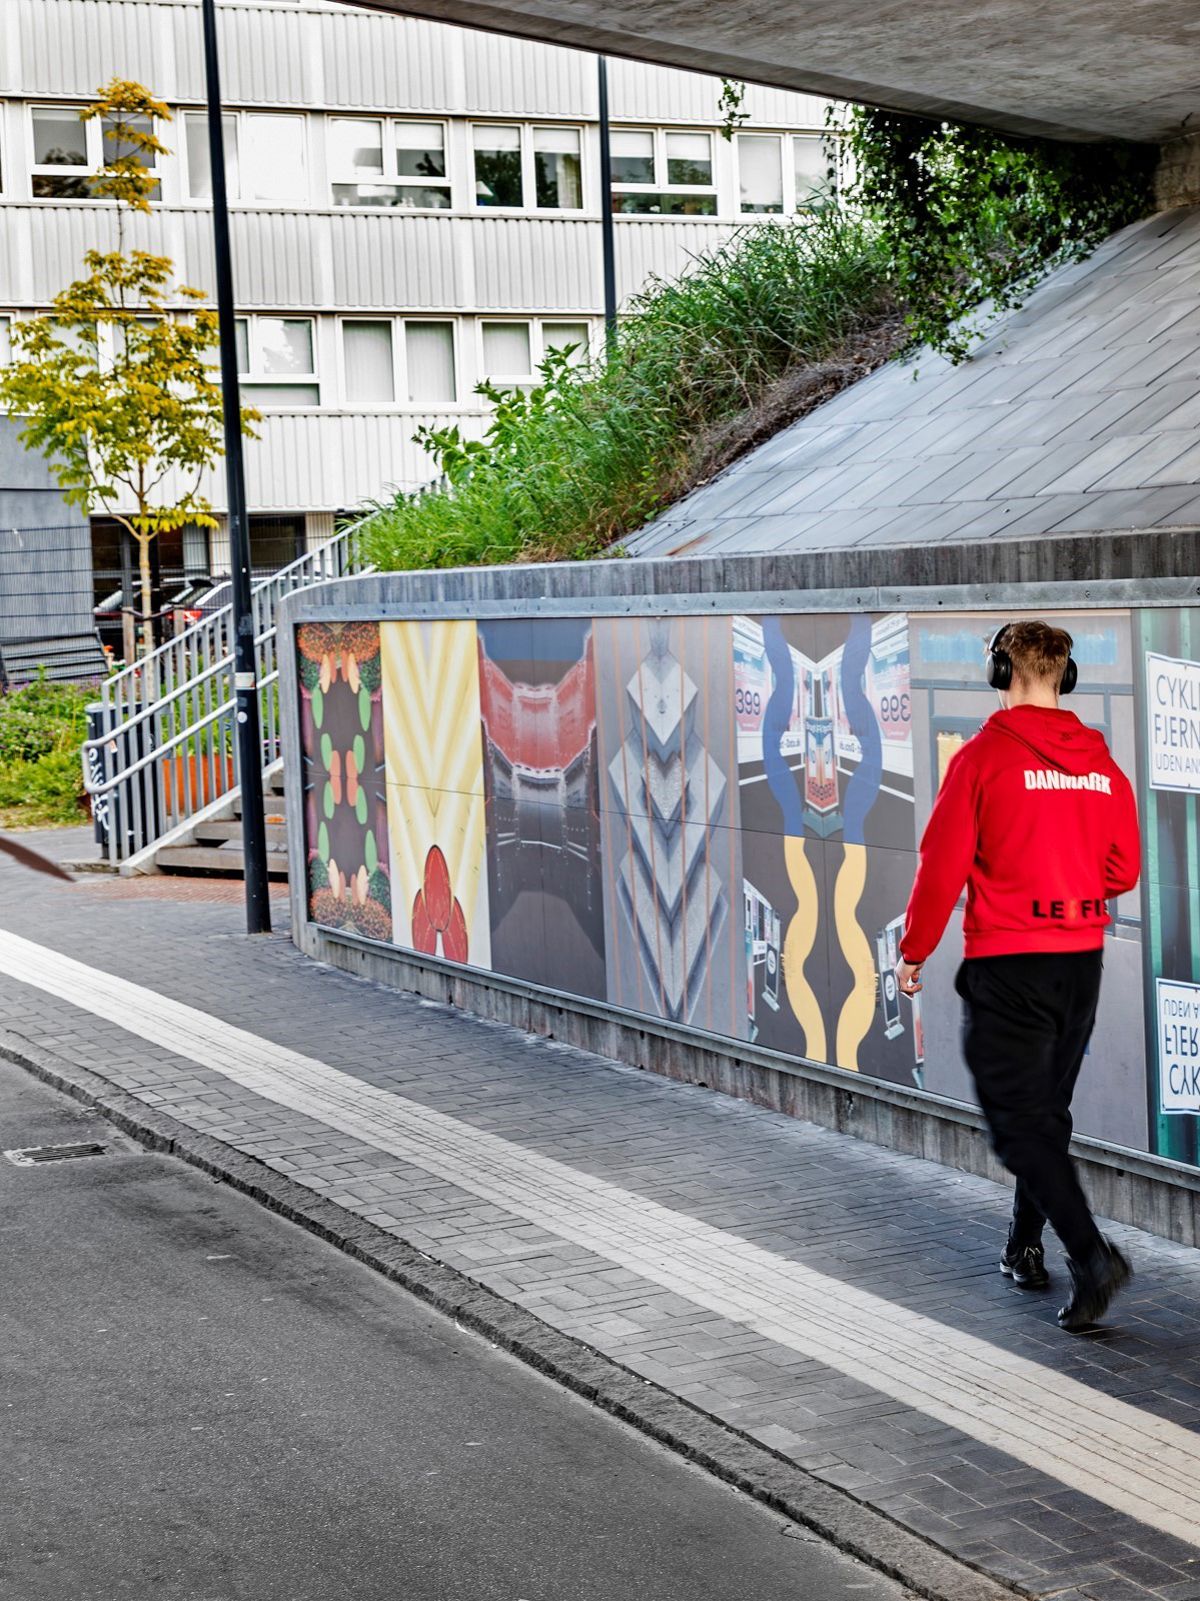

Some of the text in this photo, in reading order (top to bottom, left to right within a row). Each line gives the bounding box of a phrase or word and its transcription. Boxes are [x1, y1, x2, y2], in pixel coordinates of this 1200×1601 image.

[735, 688, 762, 716] 399
[1155, 754, 1183, 775] UDEN
[1023, 769, 1112, 796] DANMARK
